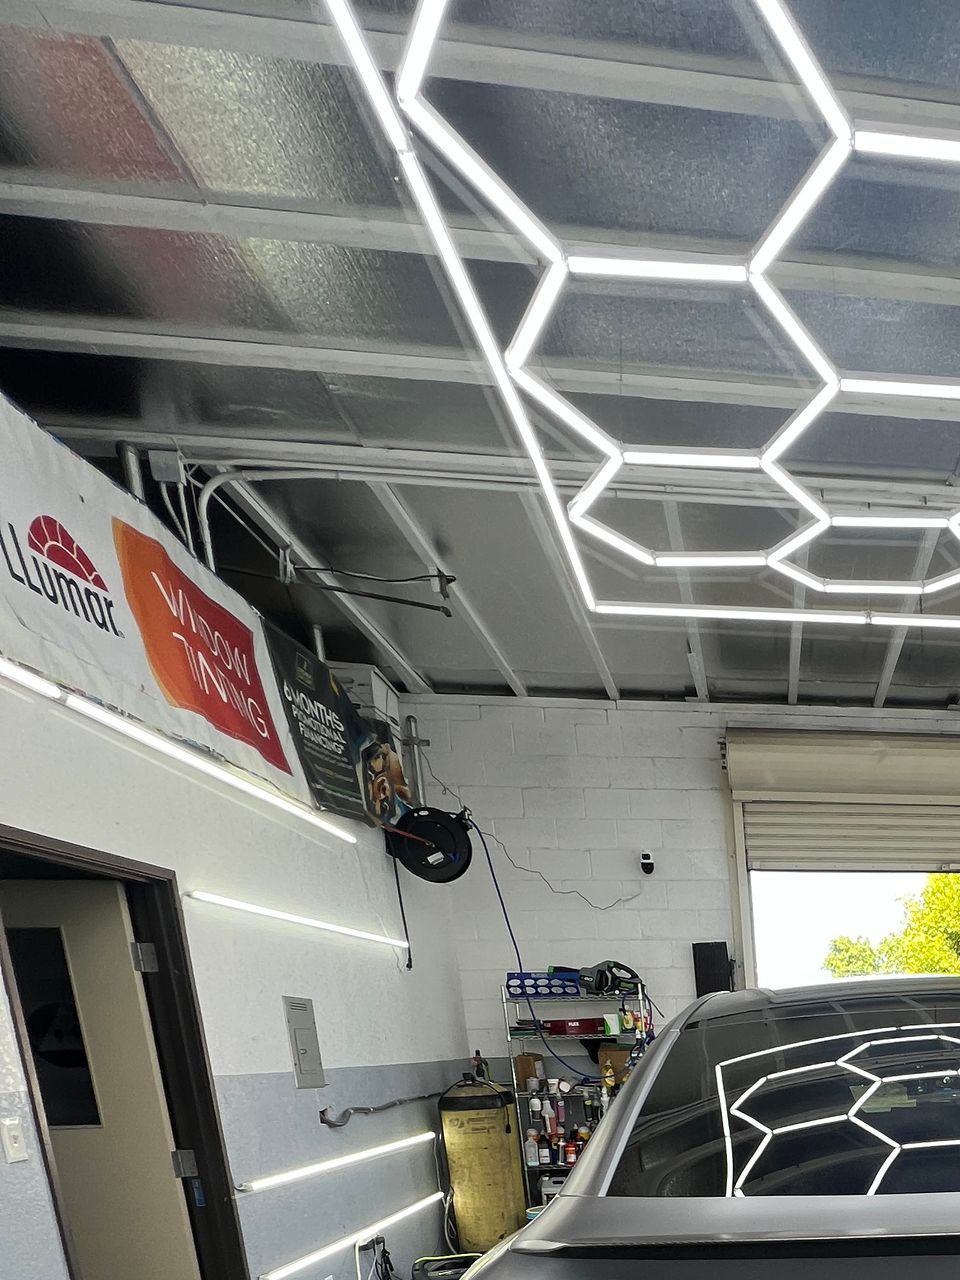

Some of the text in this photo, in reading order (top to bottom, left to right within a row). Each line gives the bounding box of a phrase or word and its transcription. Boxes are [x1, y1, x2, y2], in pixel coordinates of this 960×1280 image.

[151, 571, 251, 686] WINDOW
[172, 631, 270, 740] TINTING
[283, 679, 293, 702] 6
[291, 688, 345, 733] MONTHS
